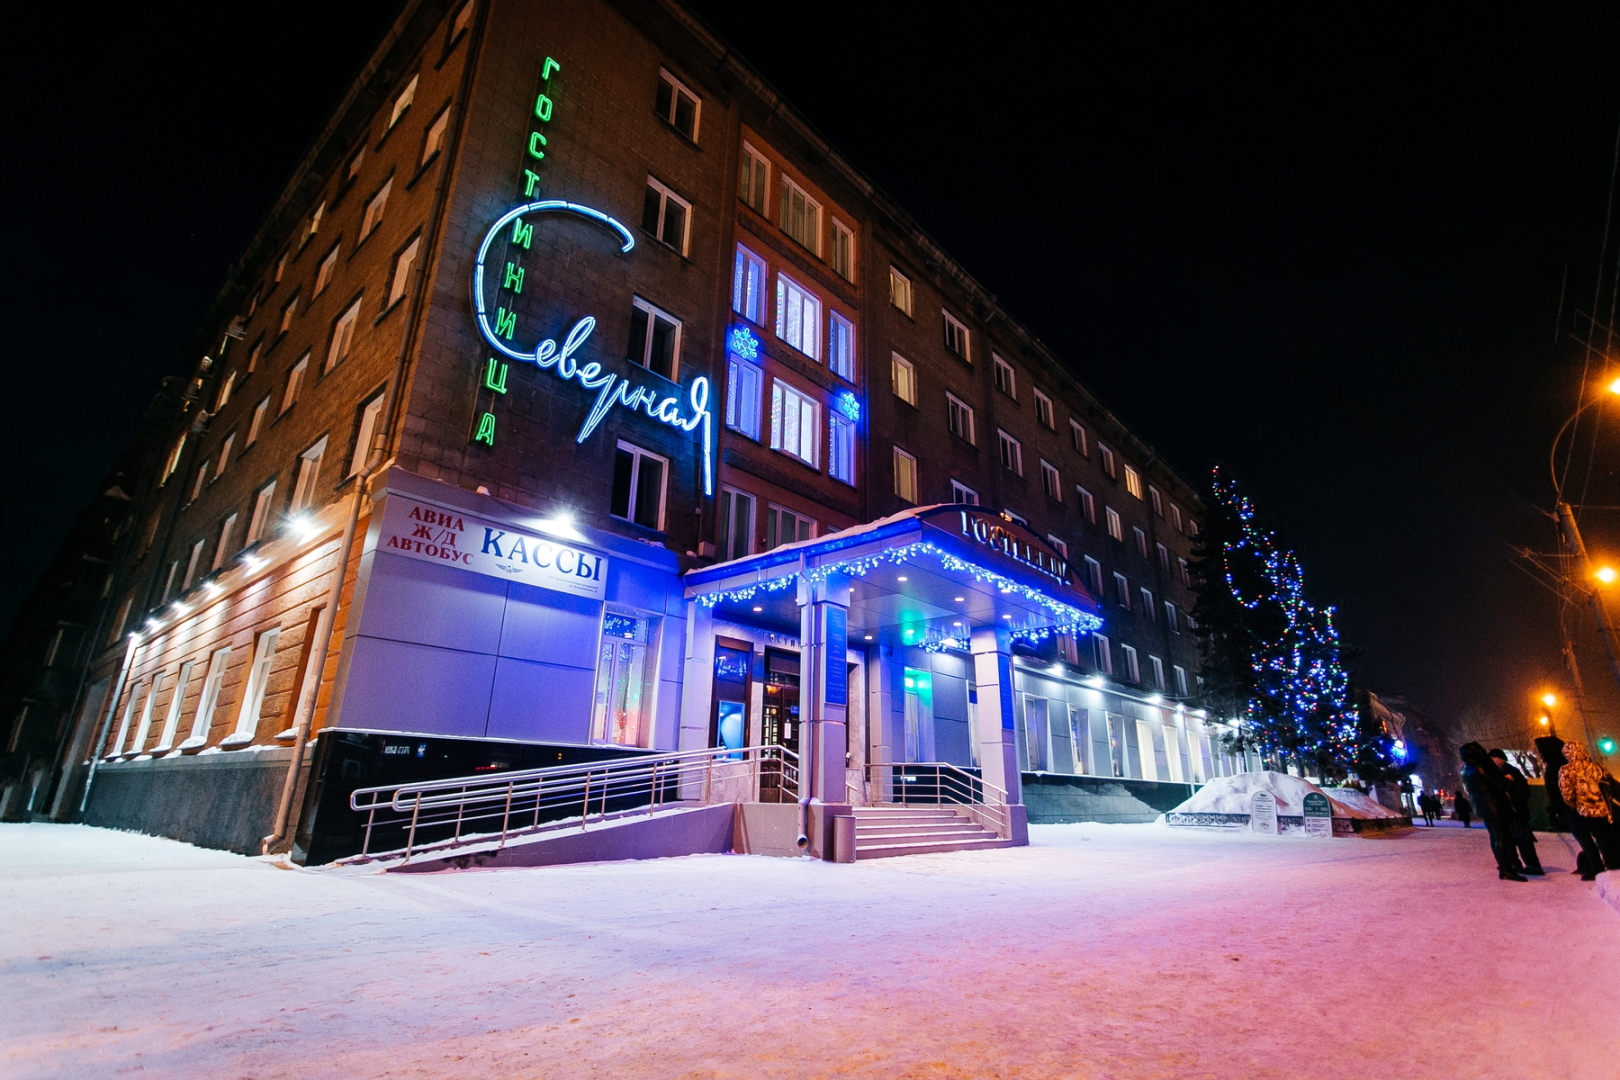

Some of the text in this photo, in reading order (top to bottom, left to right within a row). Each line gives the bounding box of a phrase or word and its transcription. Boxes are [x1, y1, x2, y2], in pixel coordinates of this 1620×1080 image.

[475, 56, 561, 446] ГОСТИНИЦА
[474, 200, 712, 496] Северная
[408, 506, 465, 532] АВИА
[411, 523, 457, 547] Ж/Д
[387, 535, 474, 565] АВТОБУС
[480, 527, 603, 582] КАССЫ
